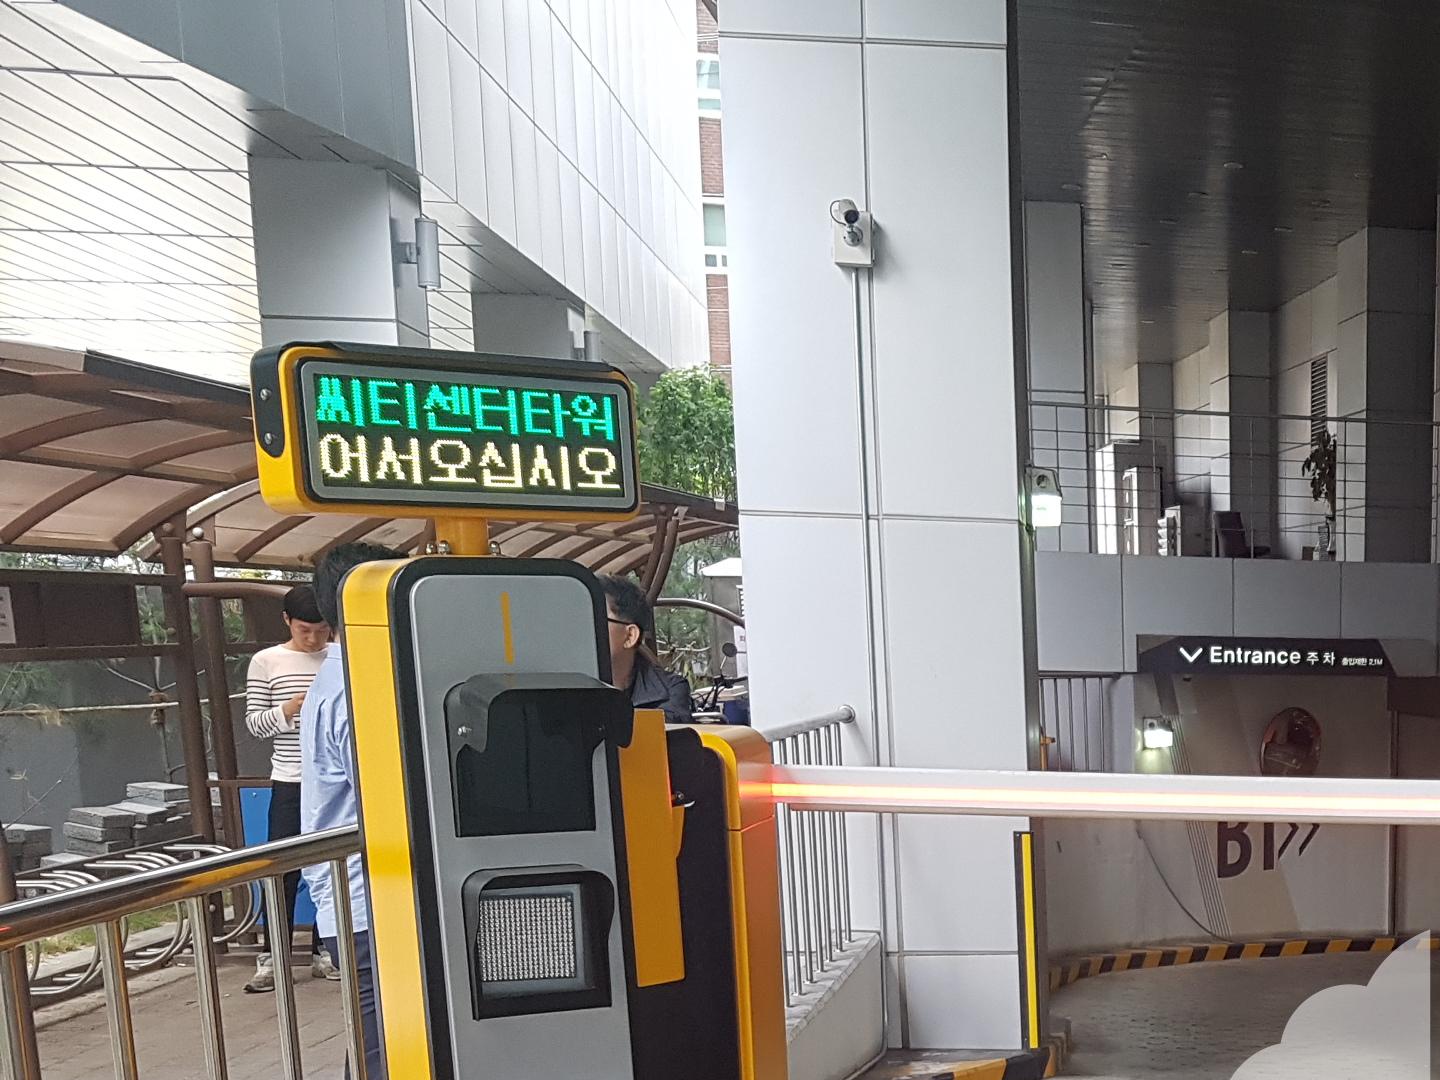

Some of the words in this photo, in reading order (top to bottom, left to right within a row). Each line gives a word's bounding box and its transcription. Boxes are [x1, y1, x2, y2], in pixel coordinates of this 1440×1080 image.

[316, 376, 616, 442] 씨티센터타워
[318, 432, 621, 492] 어서오십시오
[1209, 646, 1301, 665] Entrance
